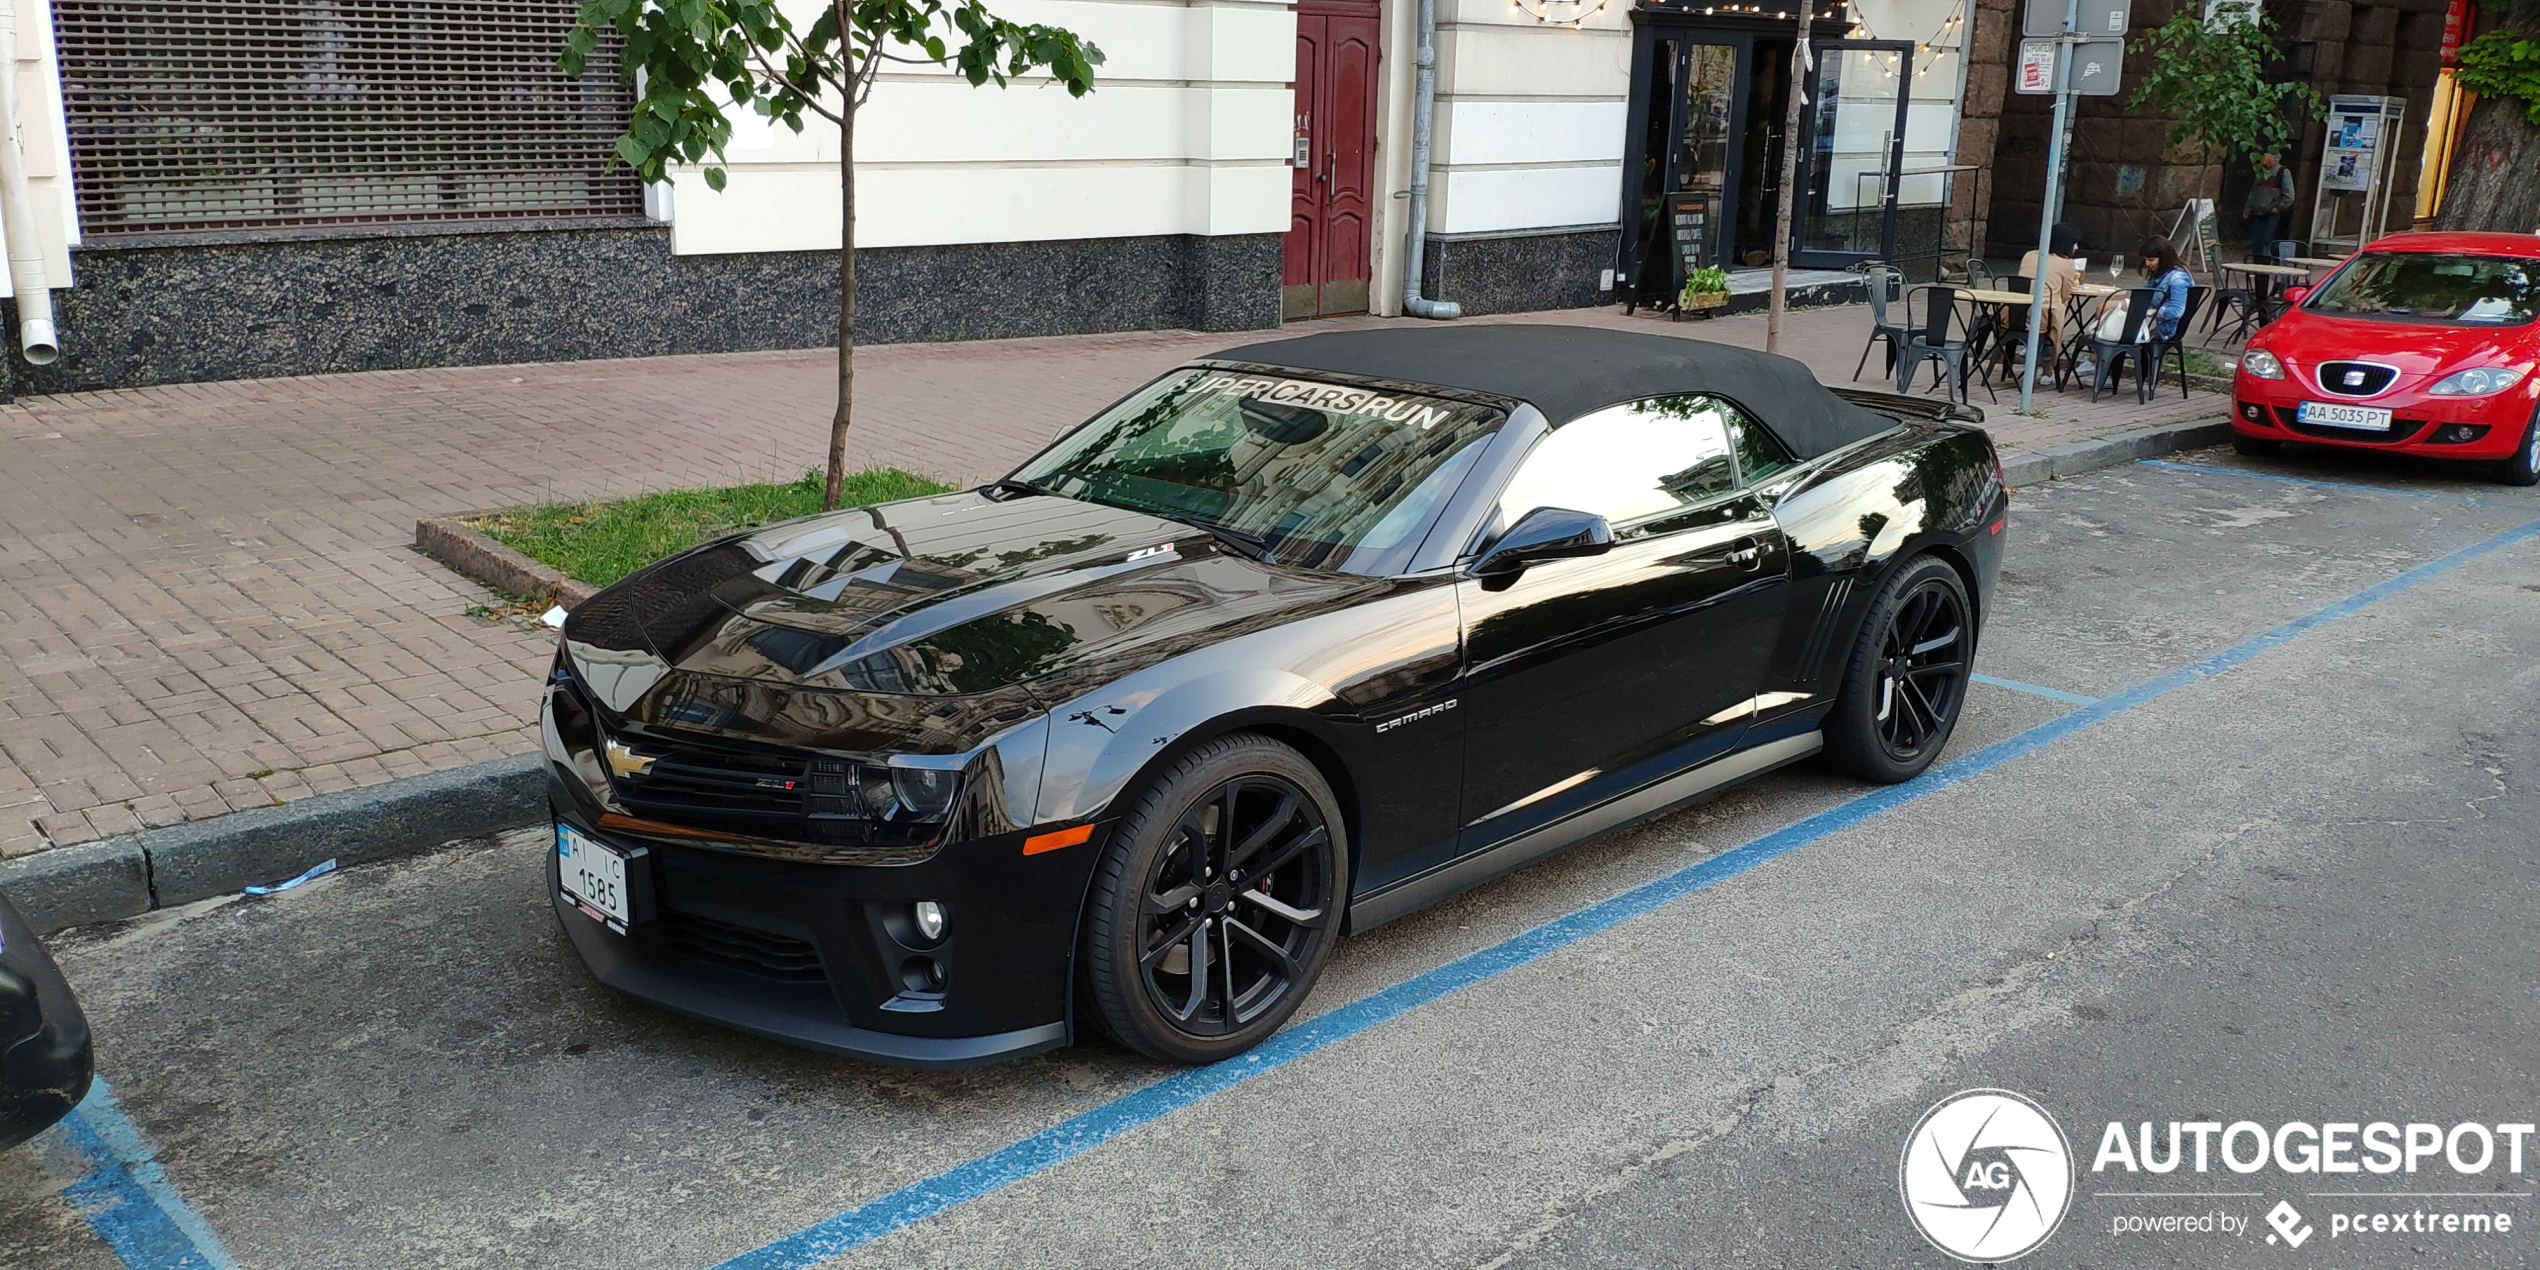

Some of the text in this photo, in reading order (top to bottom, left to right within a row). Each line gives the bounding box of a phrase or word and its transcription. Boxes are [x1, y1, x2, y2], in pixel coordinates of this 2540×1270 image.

[2307, 406, 2389, 426] AA 5035 PT
[1127, 543, 1175, 562] ZL1
[1376, 699, 1458, 733] CAMARO
[755, 778, 796, 790] ZL1
[579, 868, 617, 911] 1585
